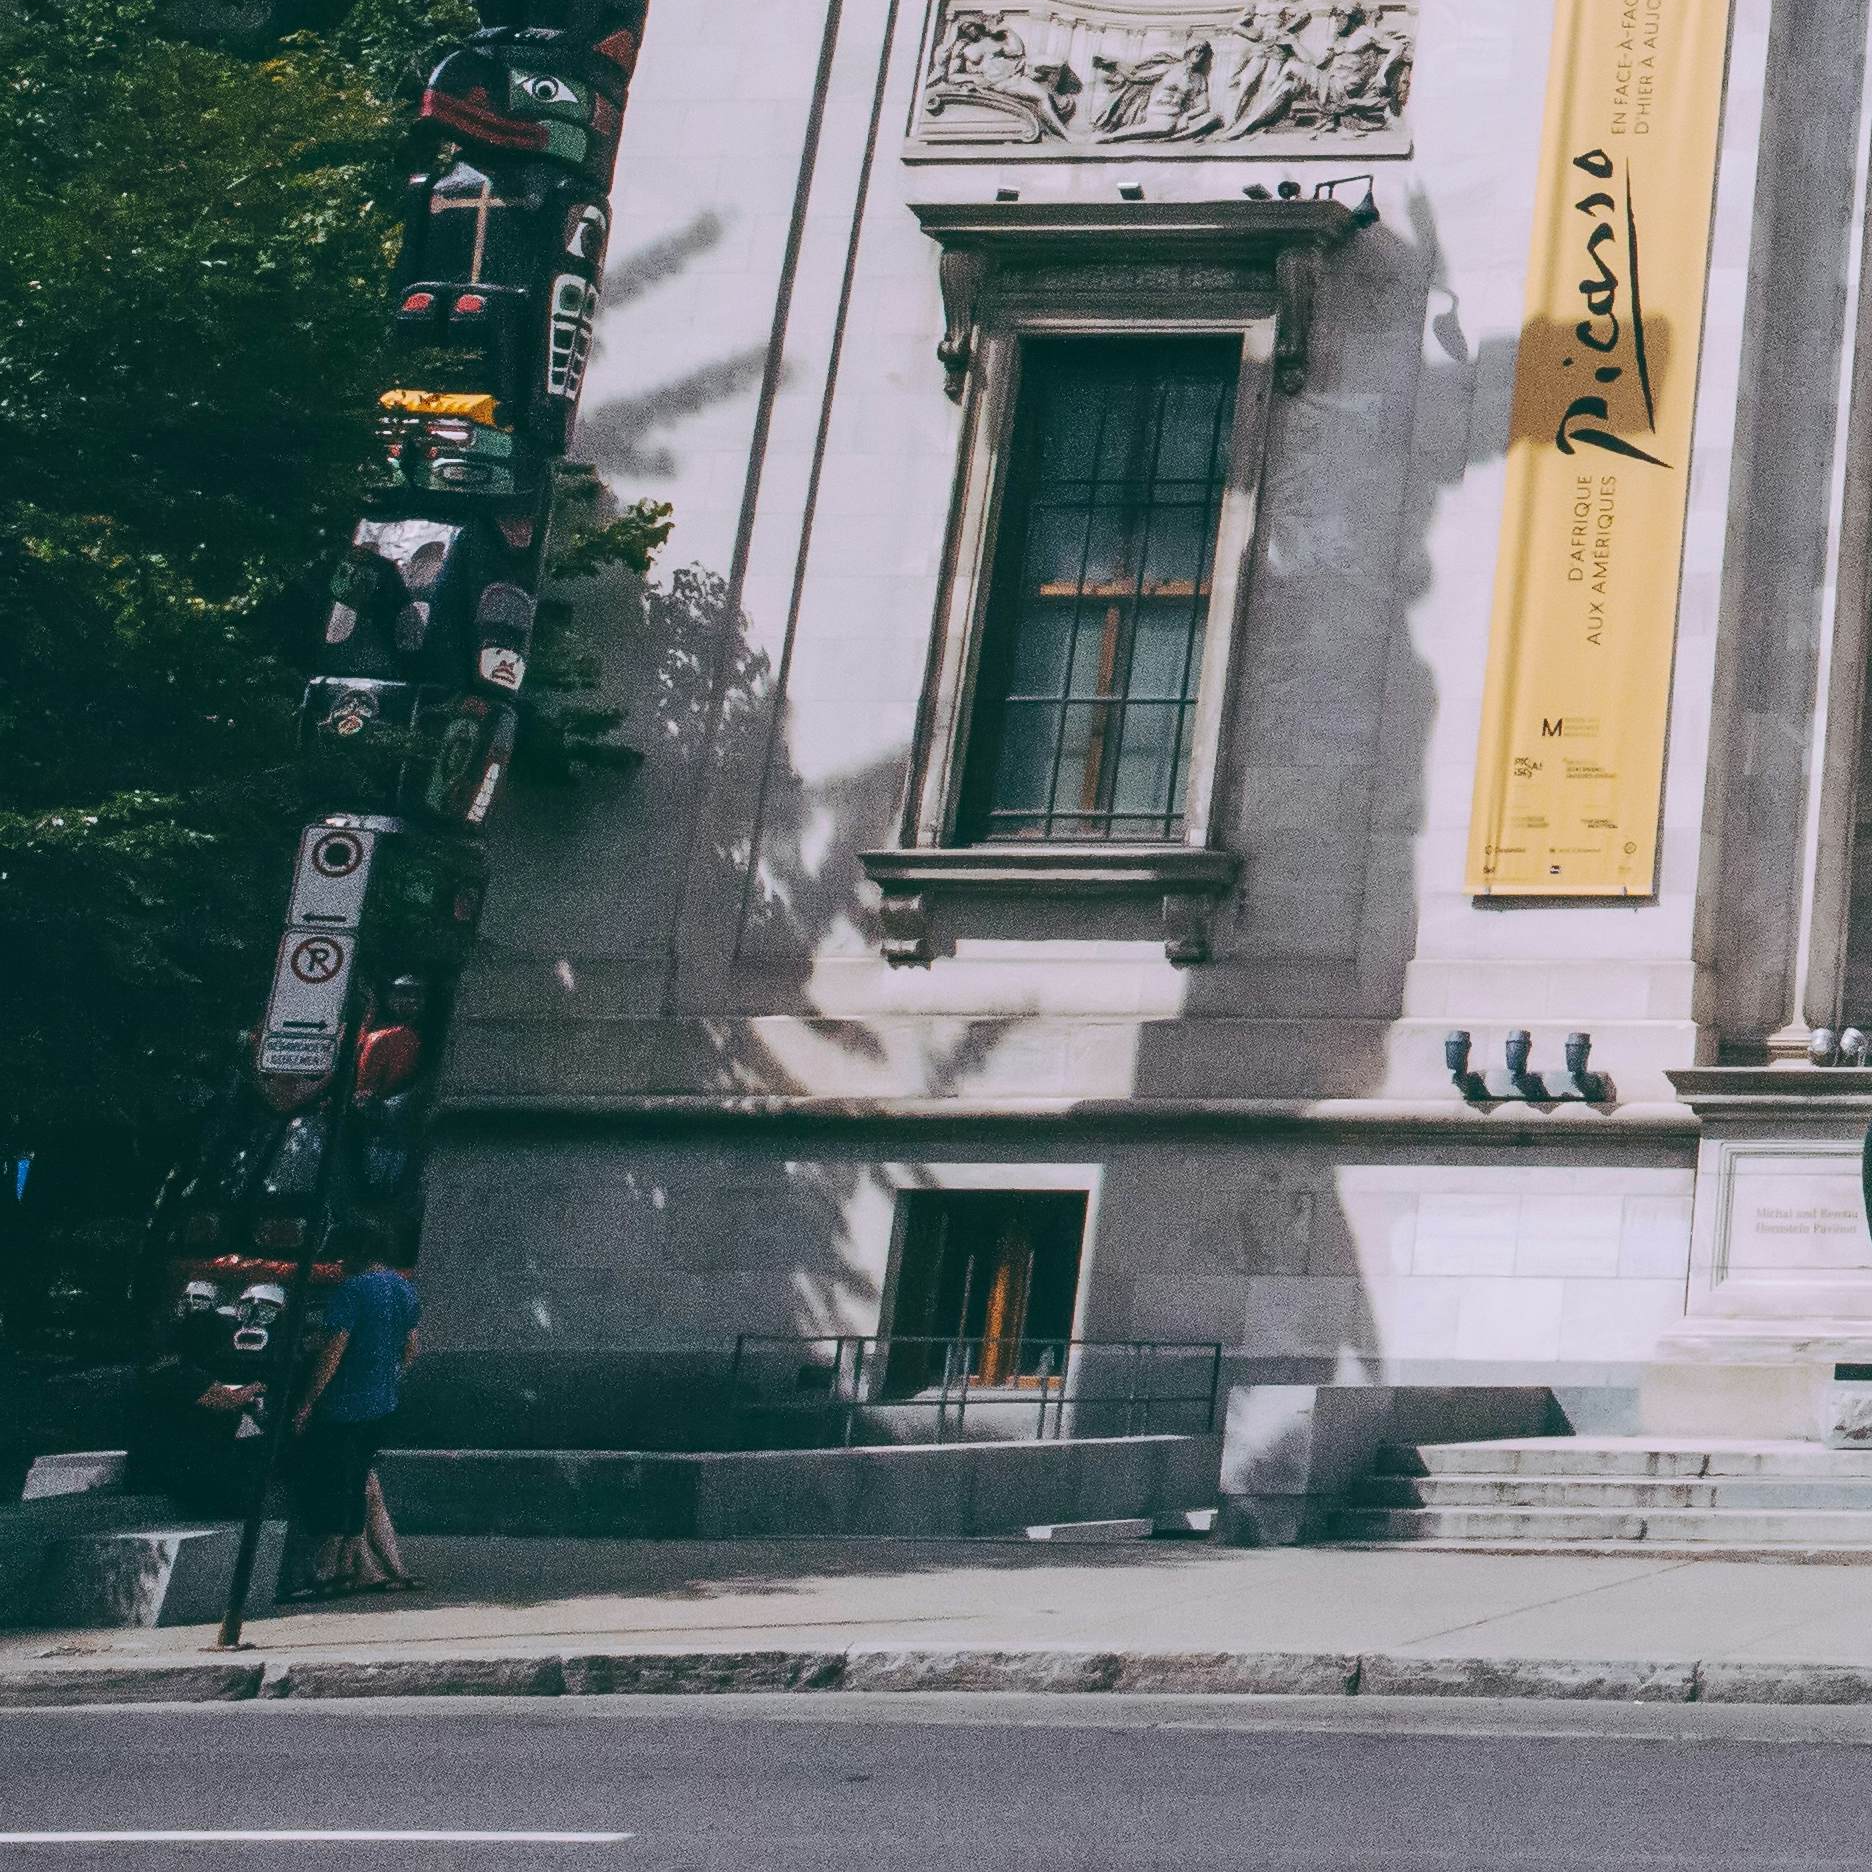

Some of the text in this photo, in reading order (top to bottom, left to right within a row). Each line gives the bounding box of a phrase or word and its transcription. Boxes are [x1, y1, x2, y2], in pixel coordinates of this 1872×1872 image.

[1611, 111, 1628, 135] EN
[1634, 74, 1655, 135] D'HIER
[1567, 474, 1593, 582] D'AFRIQUE
[1586, 474, 1617, 646] AUX AMÉRIQUES
[1541, 717, 1564, 737] M
